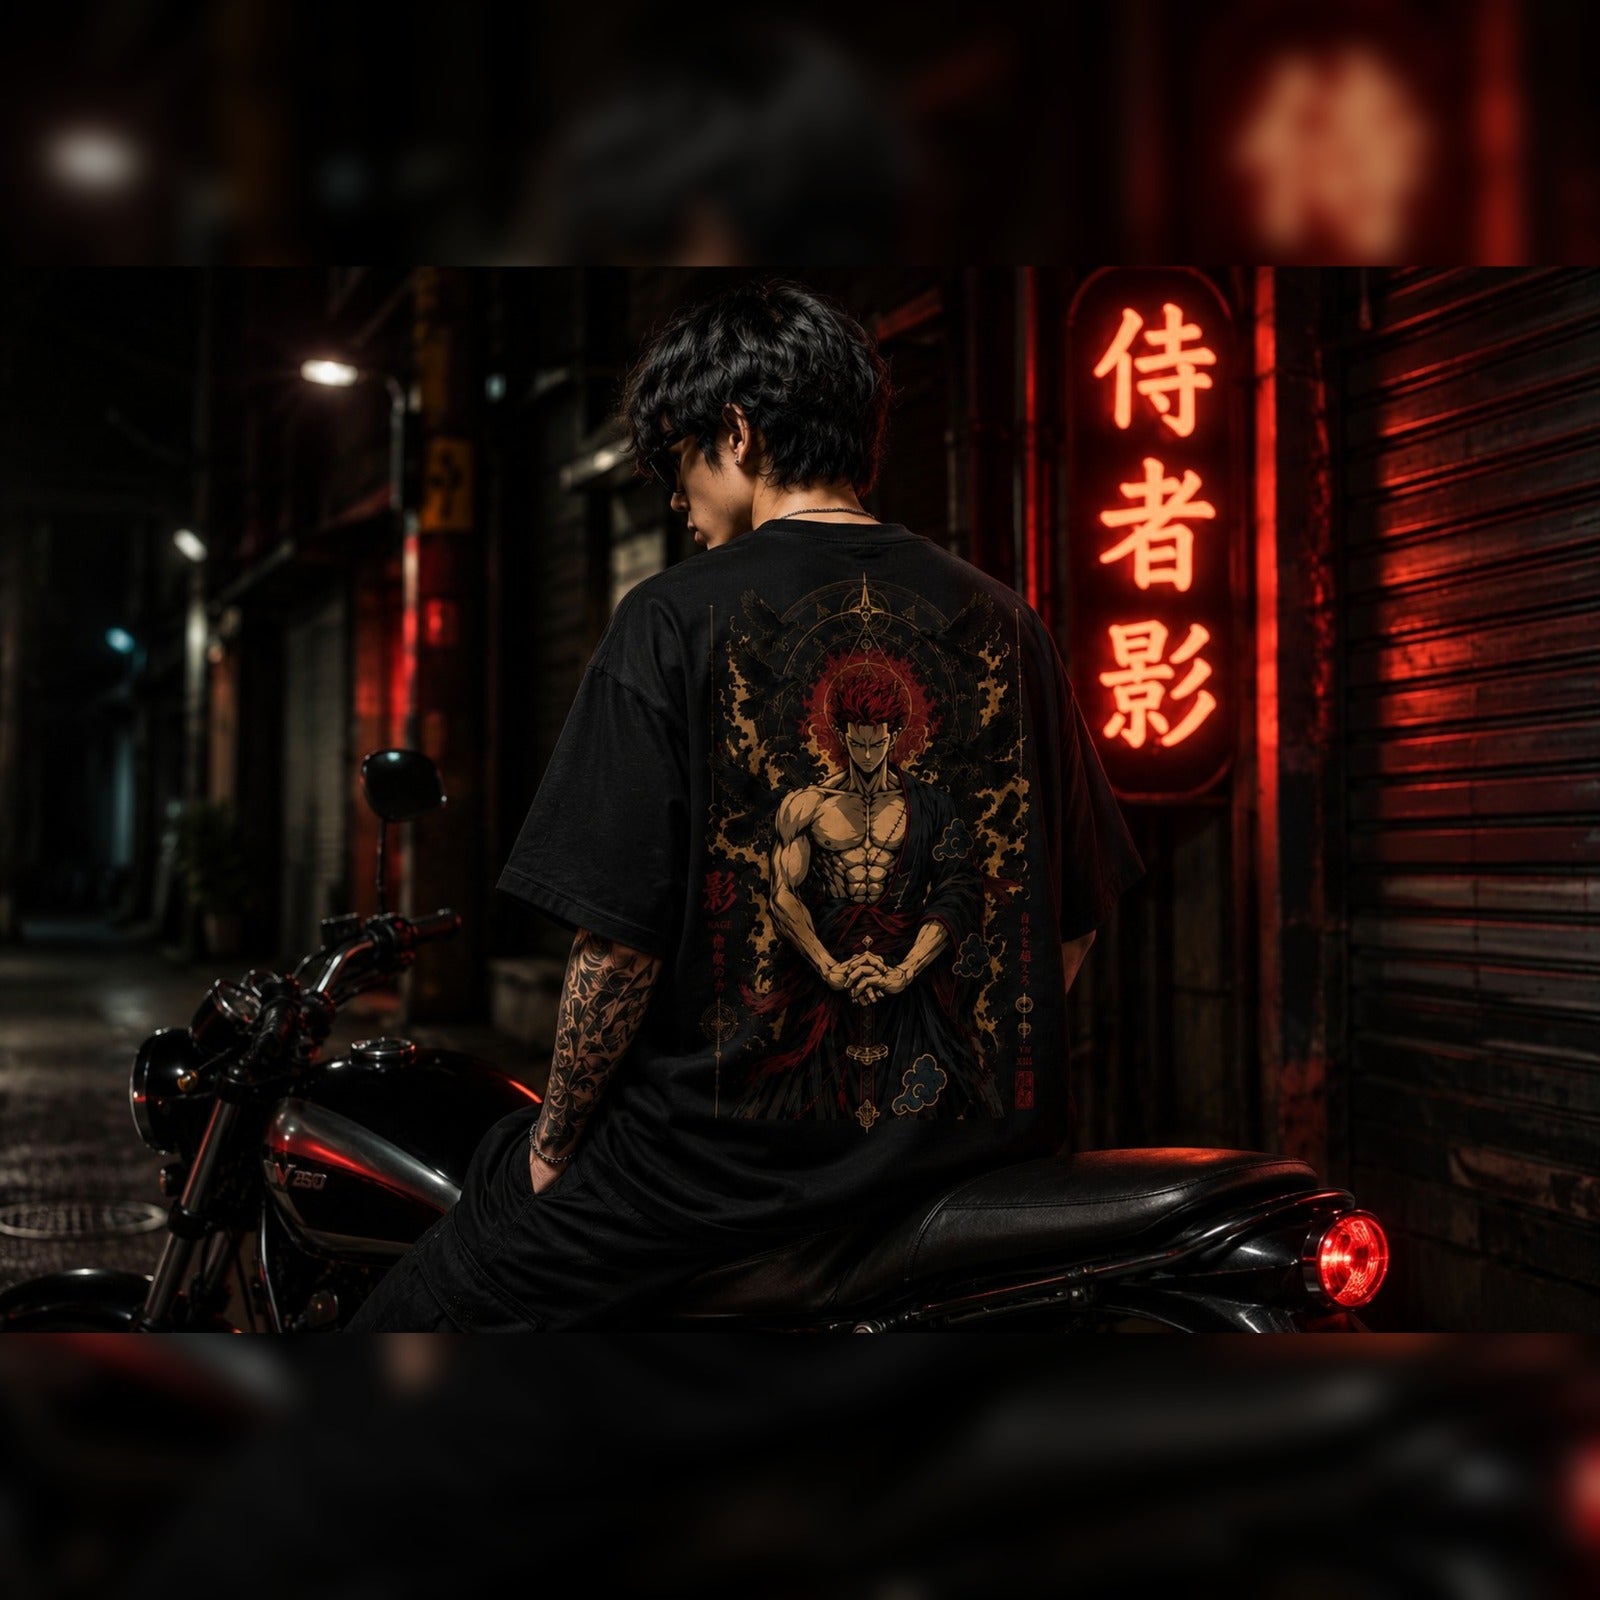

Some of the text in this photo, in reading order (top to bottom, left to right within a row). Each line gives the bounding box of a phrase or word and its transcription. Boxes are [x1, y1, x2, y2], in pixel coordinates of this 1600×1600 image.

[1093, 302, 1217, 748] 侍者影
[703, 870, 738, 916] 影
[292, 1171, 328, 1191] 250
